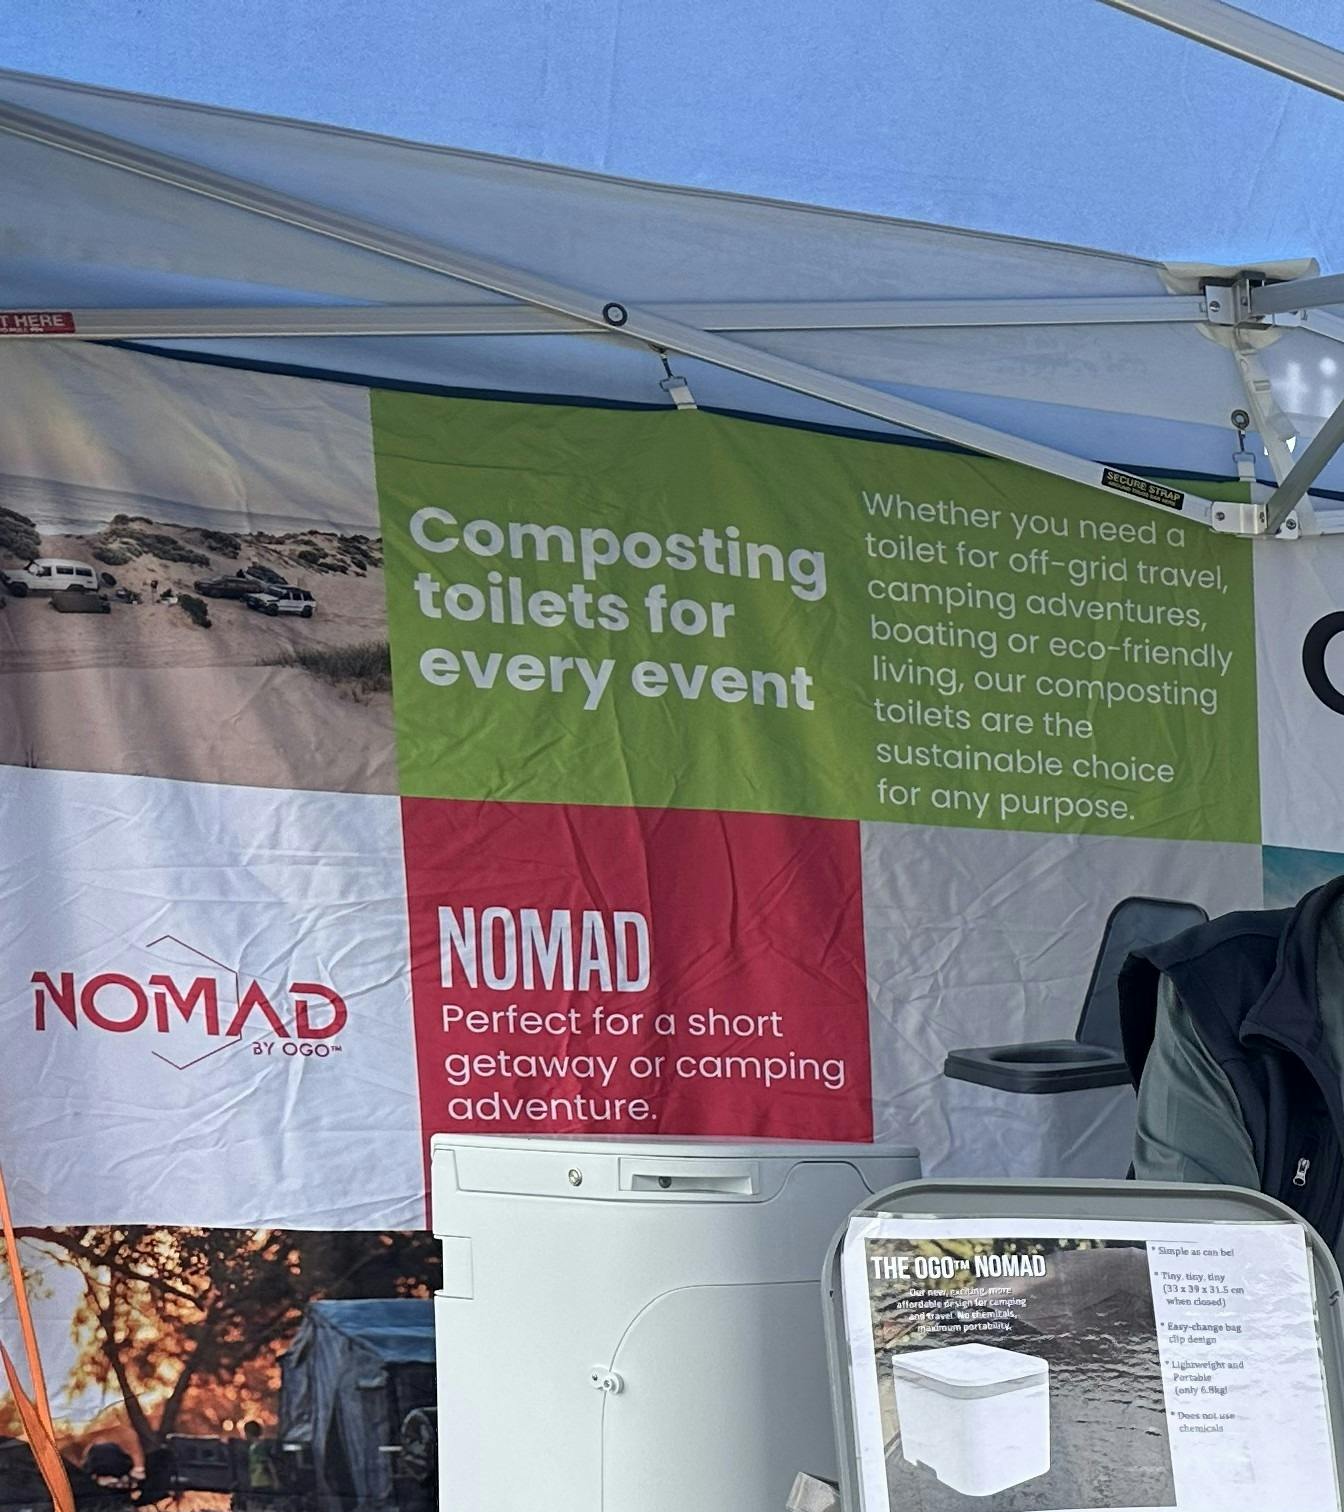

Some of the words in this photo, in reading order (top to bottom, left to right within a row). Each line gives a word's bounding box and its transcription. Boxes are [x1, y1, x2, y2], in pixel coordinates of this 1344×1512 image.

[862, 491, 1001, 529] Whether
[1010, 512, 1068, 539] you
[1080, 520, 1156, 544] need
[1167, 528, 1184, 547] a
[410, 507, 826, 601] Composting
[865, 533, 947, 564] toilet
[956, 541, 999, 568] for
[1009, 549, 1127, 586] off-grid
[1137, 561, 1227, 594] travel,
[414, 571, 629, 631] toilets
[645, 584, 735, 638] for
[868, 580, 1015, 619] camping
[1027, 592, 1207, 631] adventures,
[871, 614, 997, 658] boating
[1008, 634, 1039, 653] or
[1050, 637, 1232, 676] eco-friendly
[420, 648, 615, 710] every
[632, 661, 814, 710] event
[874, 655, 964, 695] living,
[975, 671, 1026, 692] our
[1036, 677, 1217, 714] composting
[874, 698, 970, 729] toilets
[982, 712, 1033, 734] are
[1043, 712, 1092, 738] the
[877, 744, 1062, 775] sustainable
[1073, 754, 1174, 782] choice
[877, 778, 920, 805] for
[932, 789, 990, 819] any
[1001, 793, 1134, 823] purpose.
[438, 906, 650, 992] NOMAD
[31, 972, 348, 1039] NOMAD
[443, 1005, 581, 1034] Perfect
[593, 1007, 643, 1034] for
[655, 1015, 675, 1035] a
[689, 1008, 783, 1037] short
[252, 1042, 275, 1055] BY
[445, 1051, 617, 1086] getaway
[630, 1057, 665, 1078] or
[677, 1057, 844, 1089] camping
[449, 1092, 656, 1120] adventure.
[870, 1256, 911, 1280] THE
[974, 1253, 1045, 1277] NOMAD
